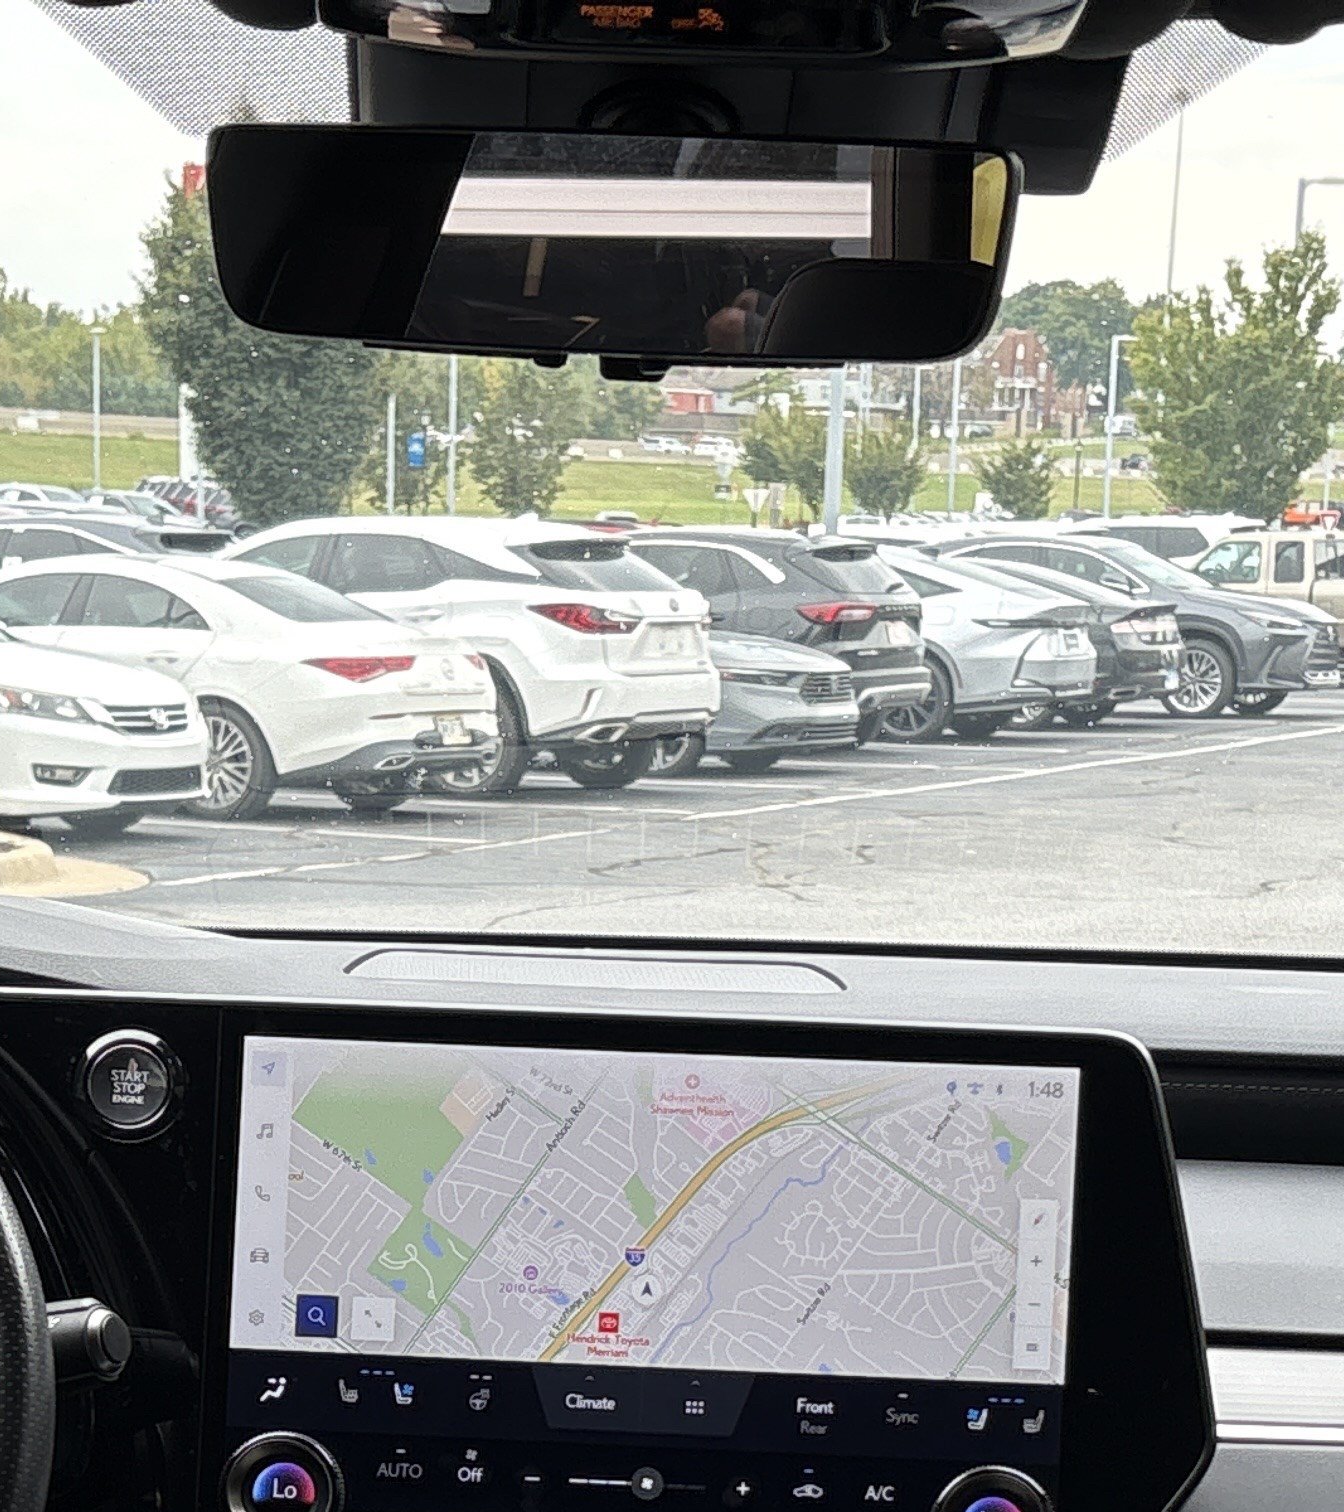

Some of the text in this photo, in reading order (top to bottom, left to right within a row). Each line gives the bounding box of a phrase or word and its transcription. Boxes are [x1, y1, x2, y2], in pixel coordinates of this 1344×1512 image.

[111, 1069, 150, 1082] START
[113, 1082, 146, 1094] STOP
[1028, 1081, 1065, 1099] 1:48
[112, 1095, 145, 1105] ENGINE
[545, 1100, 587, 1153] Antioch Rd
[567, 1333, 650, 1348] Hendrick Toyota
[565, 1393, 616, 1411] Climate
[796, 1397, 835, 1416] Front
[886, 1406, 920, 1426] Sync
[800, 1420, 828, 1436] Rear
[376, 1462, 423, 1480] AUTO
[457, 1466, 484, 1484] Off
[272, 1479, 297, 1501] Lo
[864, 1484, 896, 1502] A/C
